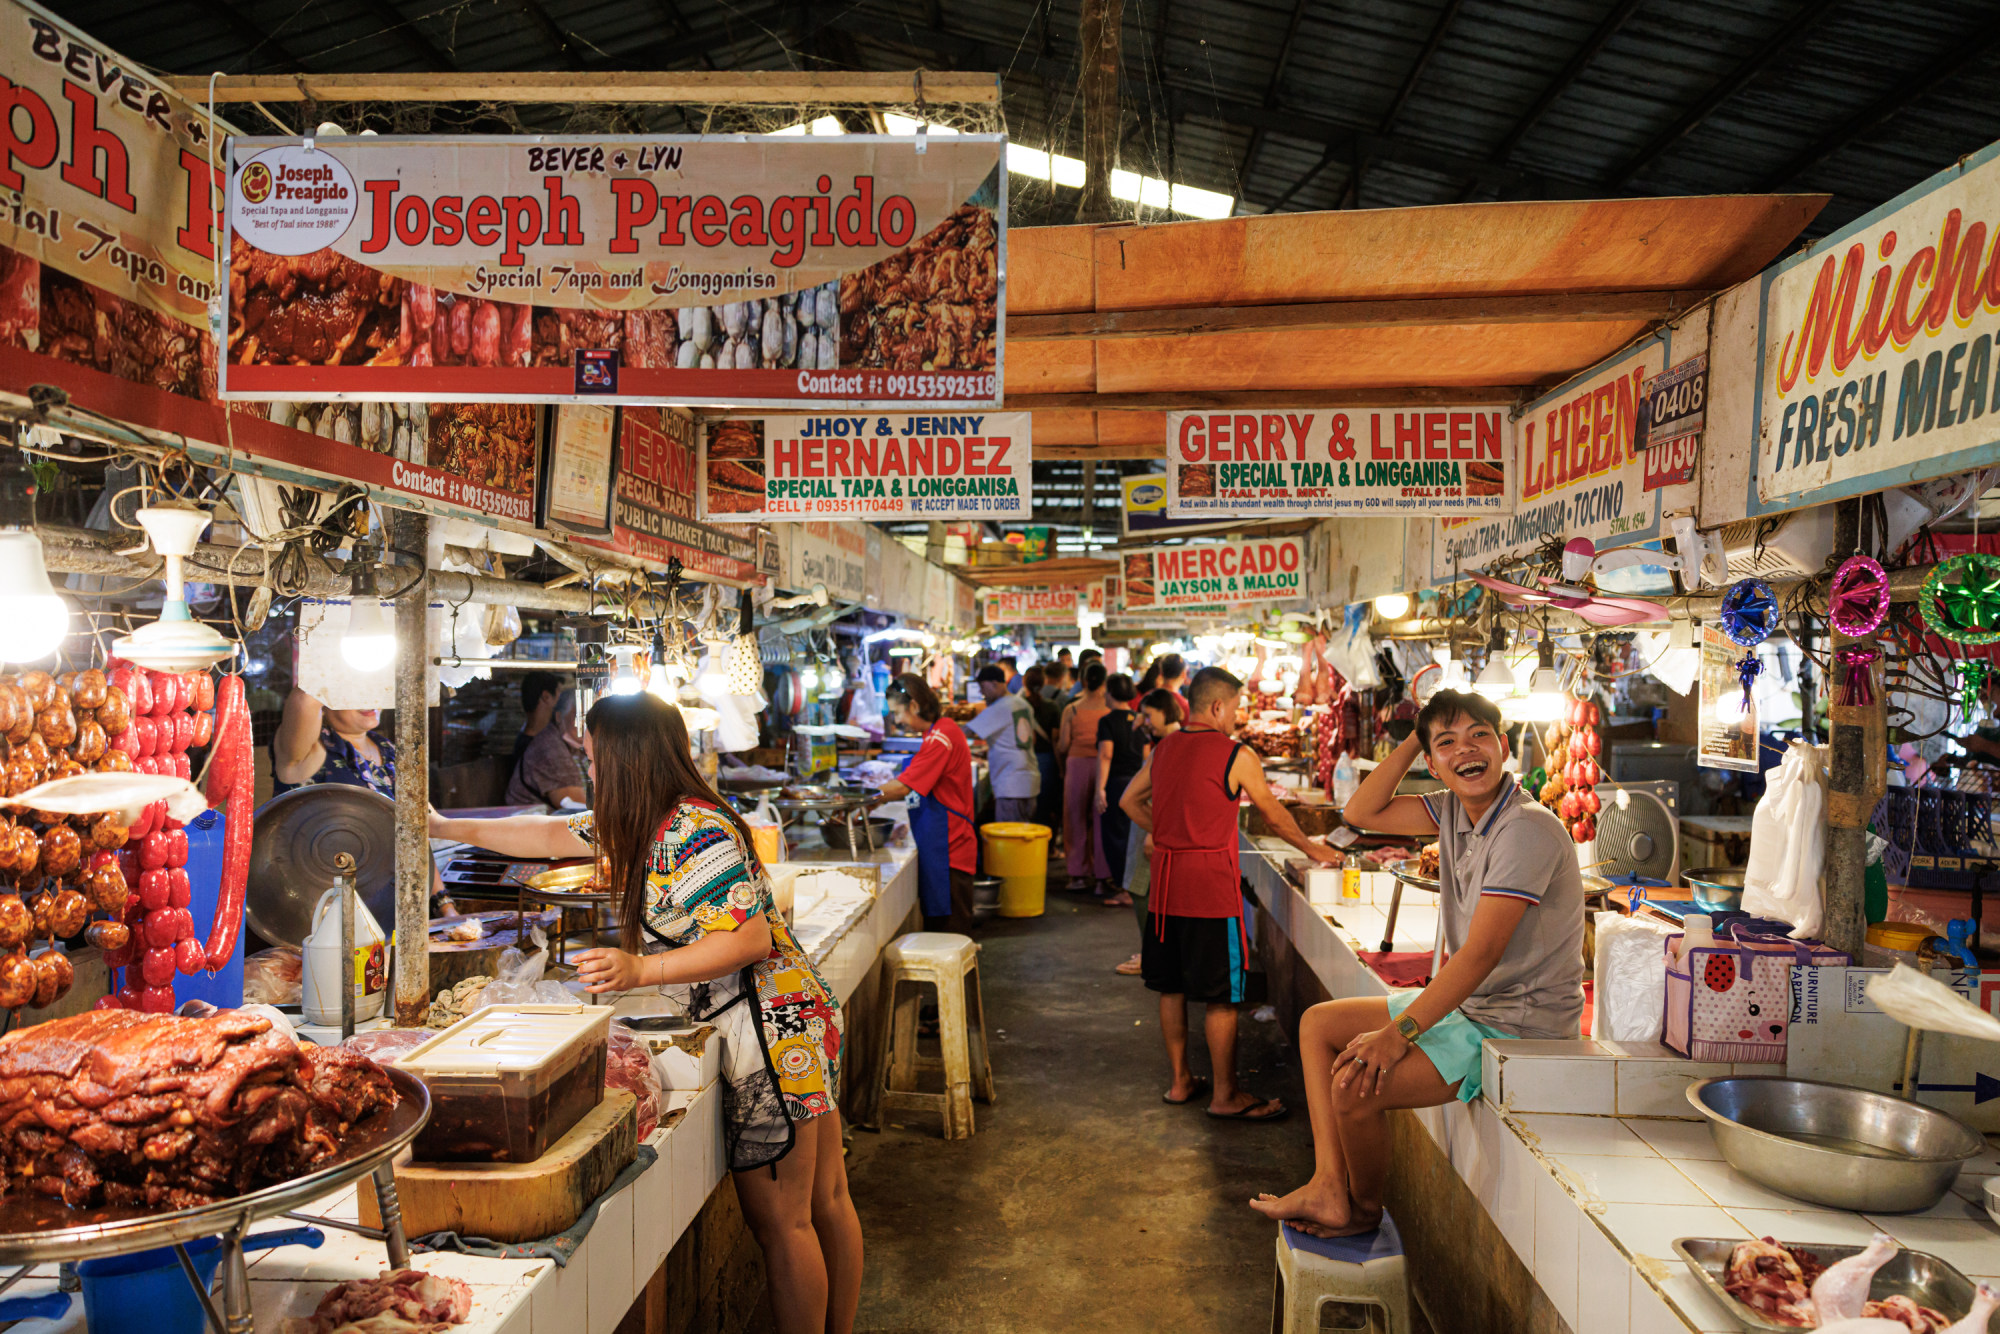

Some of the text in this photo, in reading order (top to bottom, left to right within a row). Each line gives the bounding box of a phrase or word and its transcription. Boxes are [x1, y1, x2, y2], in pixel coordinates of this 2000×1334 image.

[28, 18, 172, 131] BEVER
[528, 147, 605, 172] BEVER
[638, 146, 682, 171] LYN
[275, 164, 333, 186] Joseph
[275, 183, 348, 204] Preagido
[241, 206, 348, 216] Special Tapa and Longganisa
[271, 219, 279, 230] of
[280, 219, 295, 228] Taal
[297, 219, 314, 228] since
[360, 174, 917, 268] Joseph Preagido
[77, 221, 166, 282] Tapa
[466, 266, 776, 295] Special Tapa and Longganisa
[797, 370, 996, 398] Contact #: 09153592518
[1655, 375, 1703, 424] 0408
[660, 407, 686, 441] JHOY
[800, 416, 984, 437] JHOY & JENNY
[1523, 366, 1645, 502] LHEEN
[1775, 370, 1887, 473] FRESH
[1179, 412, 1502, 462] GERRY & LHEEN
[774, 437, 1012, 477] HERNANDEZ
[768, 477, 1019, 498] SPECIAL TAPA & LONGGANISA
[1220, 461, 1462, 488] SPECIAL TAPA & LONGGANISA
[393, 461, 530, 519] Contact #: 09153592518
[662, 490, 689, 518] TAPA
[1180, 498, 1501, 510] And with all his abundant wealth through christ jesus my GOD will supply all your needs (Phil. 4:19)
[1219, 488, 1332, 498] TAAL PUB. MKT.
[1401, 487, 1462, 497] STALL # 154
[768, 499, 903, 513] CELL # 09351170449
[911, 498, 1020, 511] WE ACCEPT MADE TO ORDER
[1480, 521, 1500, 554] TAPA
[1506, 499, 1566, 547] LONGGANISA
[1574, 481, 1623, 529] TOCINO
[616, 501, 659, 533] PUBLIC
[706, 532, 728, 555] TAAL
[1610, 511, 1646, 534] STALL 154
[629, 533, 669, 562] Contact
[1157, 542, 1299, 581] MERCADO
[1160, 573, 1299, 597] JAYSON & MALOU
[1165, 588, 1297, 605] SPECIAL TAPA & LONGANIZA
[1000, 593, 1077, 610] REY LEGASPI
[1789, 965, 1802, 1023] PARTITION
[1807, 965, 1818, 1024] FURNITURE
